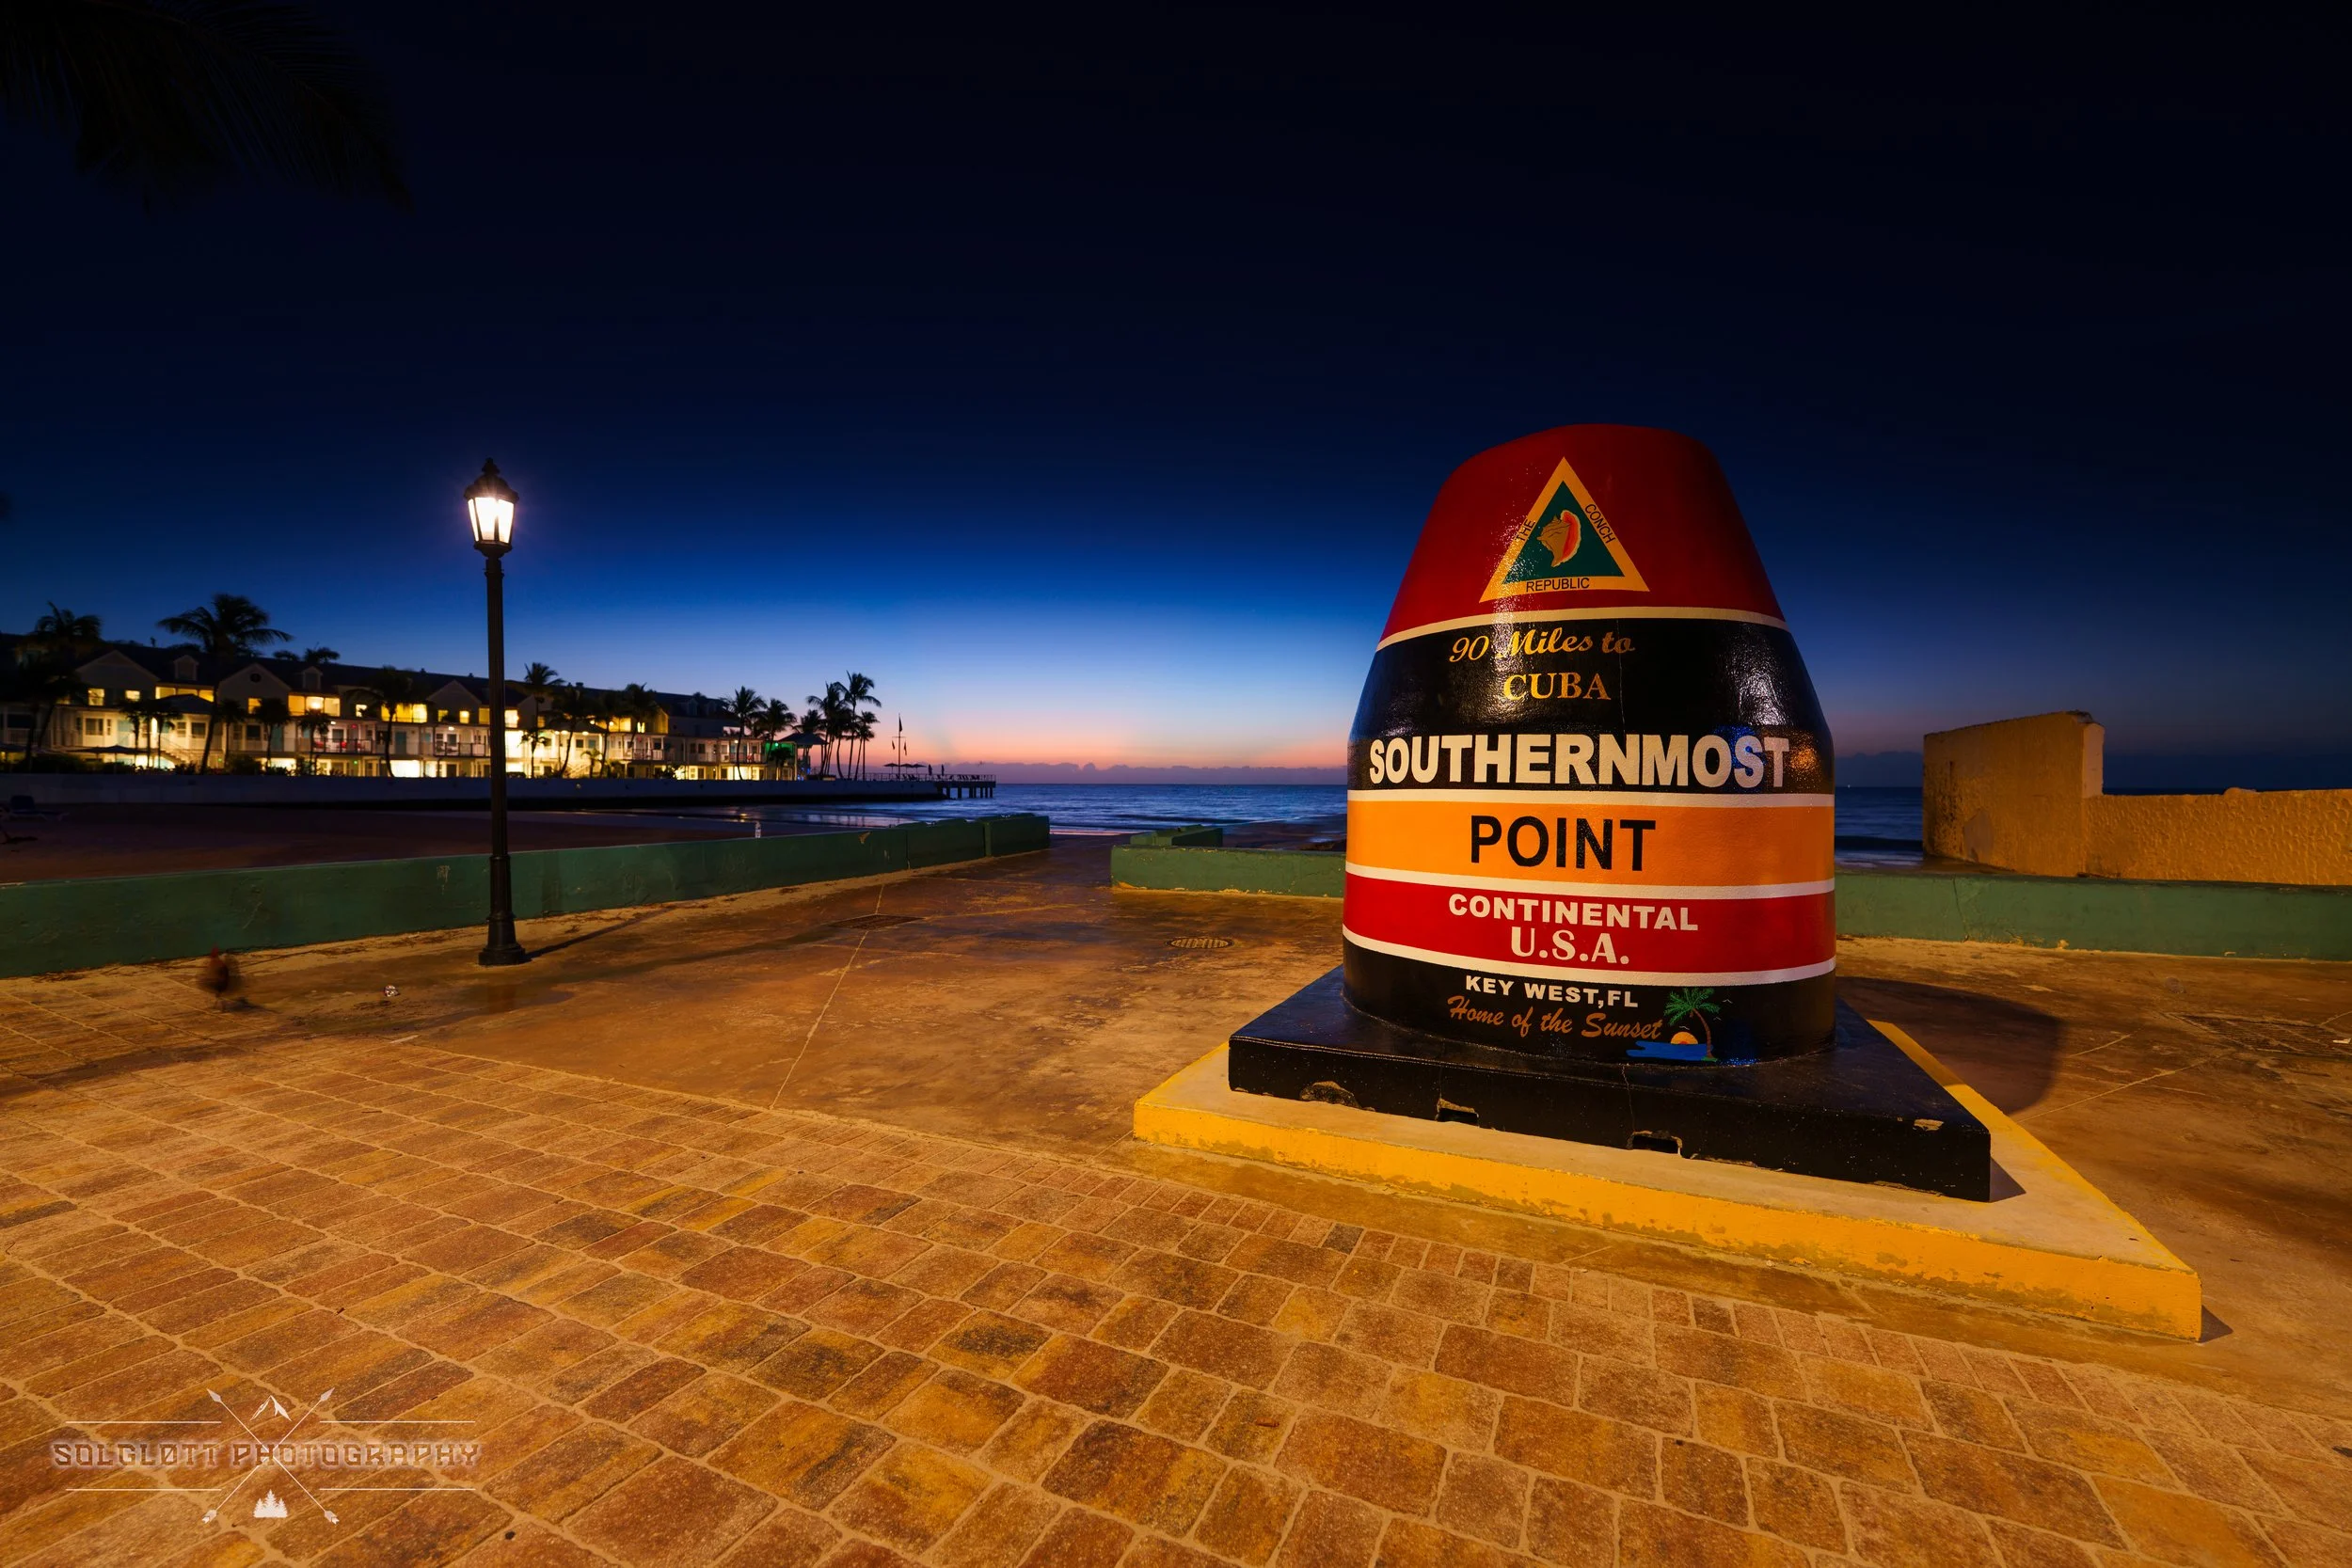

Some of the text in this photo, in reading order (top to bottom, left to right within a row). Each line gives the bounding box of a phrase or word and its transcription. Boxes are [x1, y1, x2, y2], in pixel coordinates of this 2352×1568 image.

[1515, 519, 1535, 542] THE
[1585, 503, 1616, 544] CONCH
[1526, 577, 1590, 593] REPUBLIC
[1450, 627, 1635, 662] 90 Miles to
[1503, 671, 1612, 701] CUBA
[1369, 734, 1789, 788] SOUTHERNMOST
[1470, 815, 1656, 871] POINT
[1449, 894, 1698, 930] CONTINENTAL
[1511, 927, 1629, 965] U.S.A.
[1466, 974, 1514, 996] KEY
[1447, 995, 1662, 1039] Home of the Sunset
